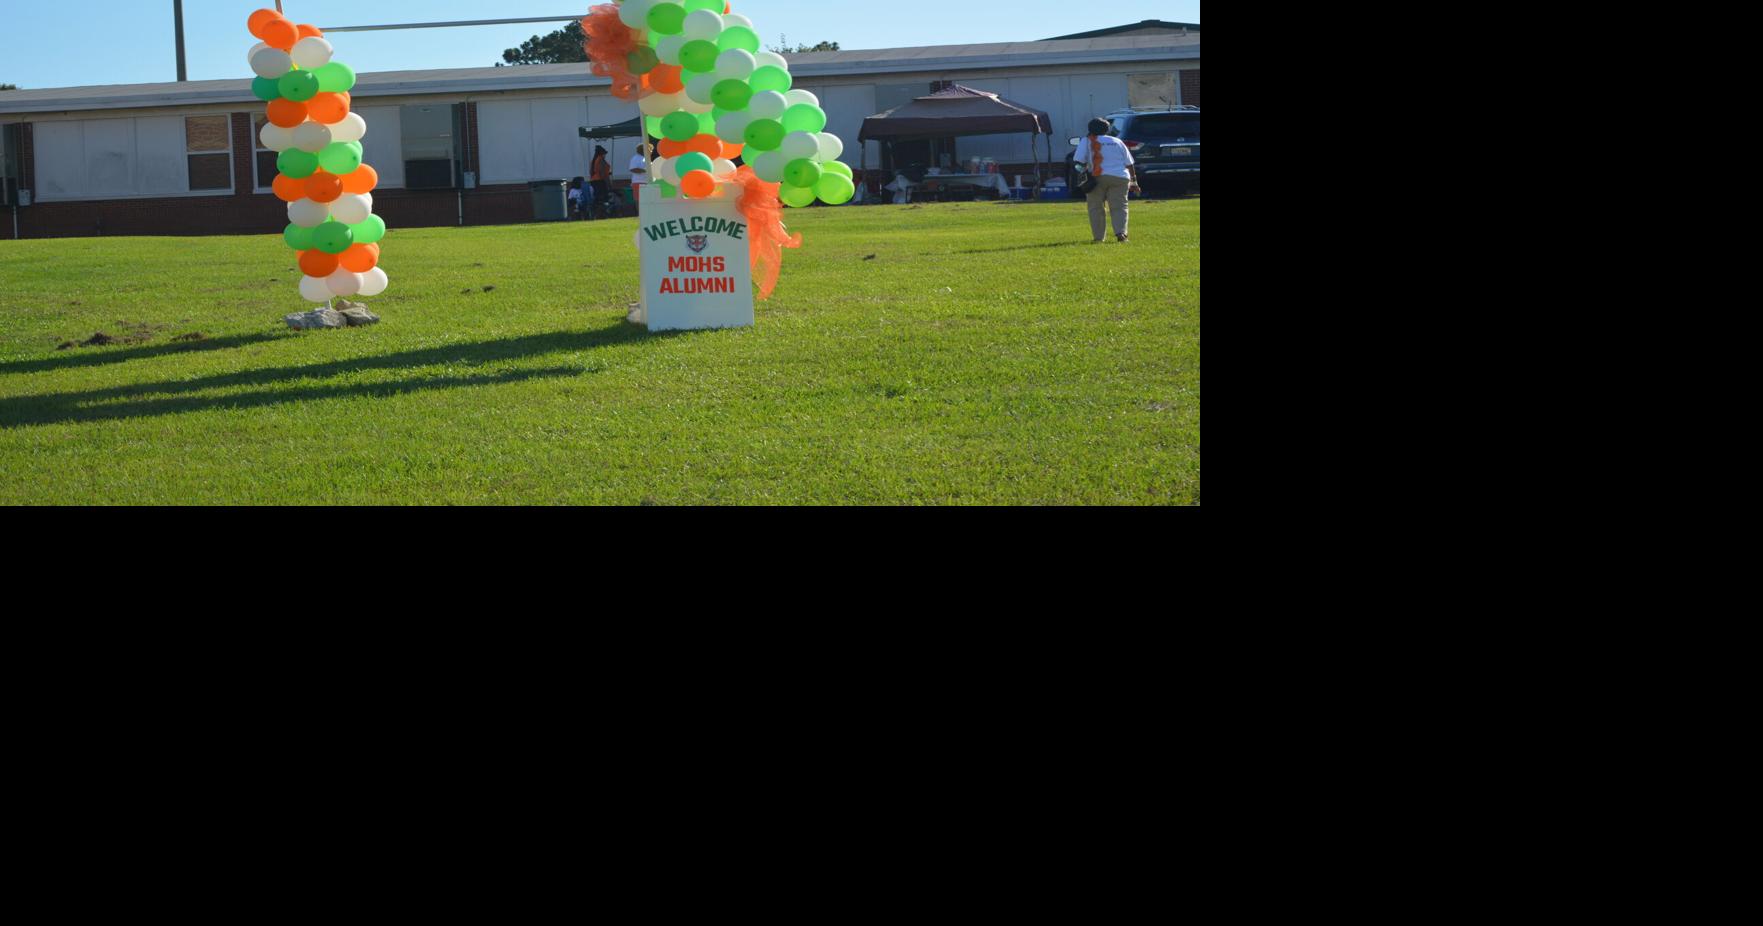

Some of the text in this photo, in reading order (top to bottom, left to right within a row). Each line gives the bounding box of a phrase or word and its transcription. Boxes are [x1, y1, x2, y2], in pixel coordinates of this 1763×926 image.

[644, 216, 747, 241] WELCOME
[668, 256, 725, 272] MOHS
[659, 277, 735, 294] ALUMNI
